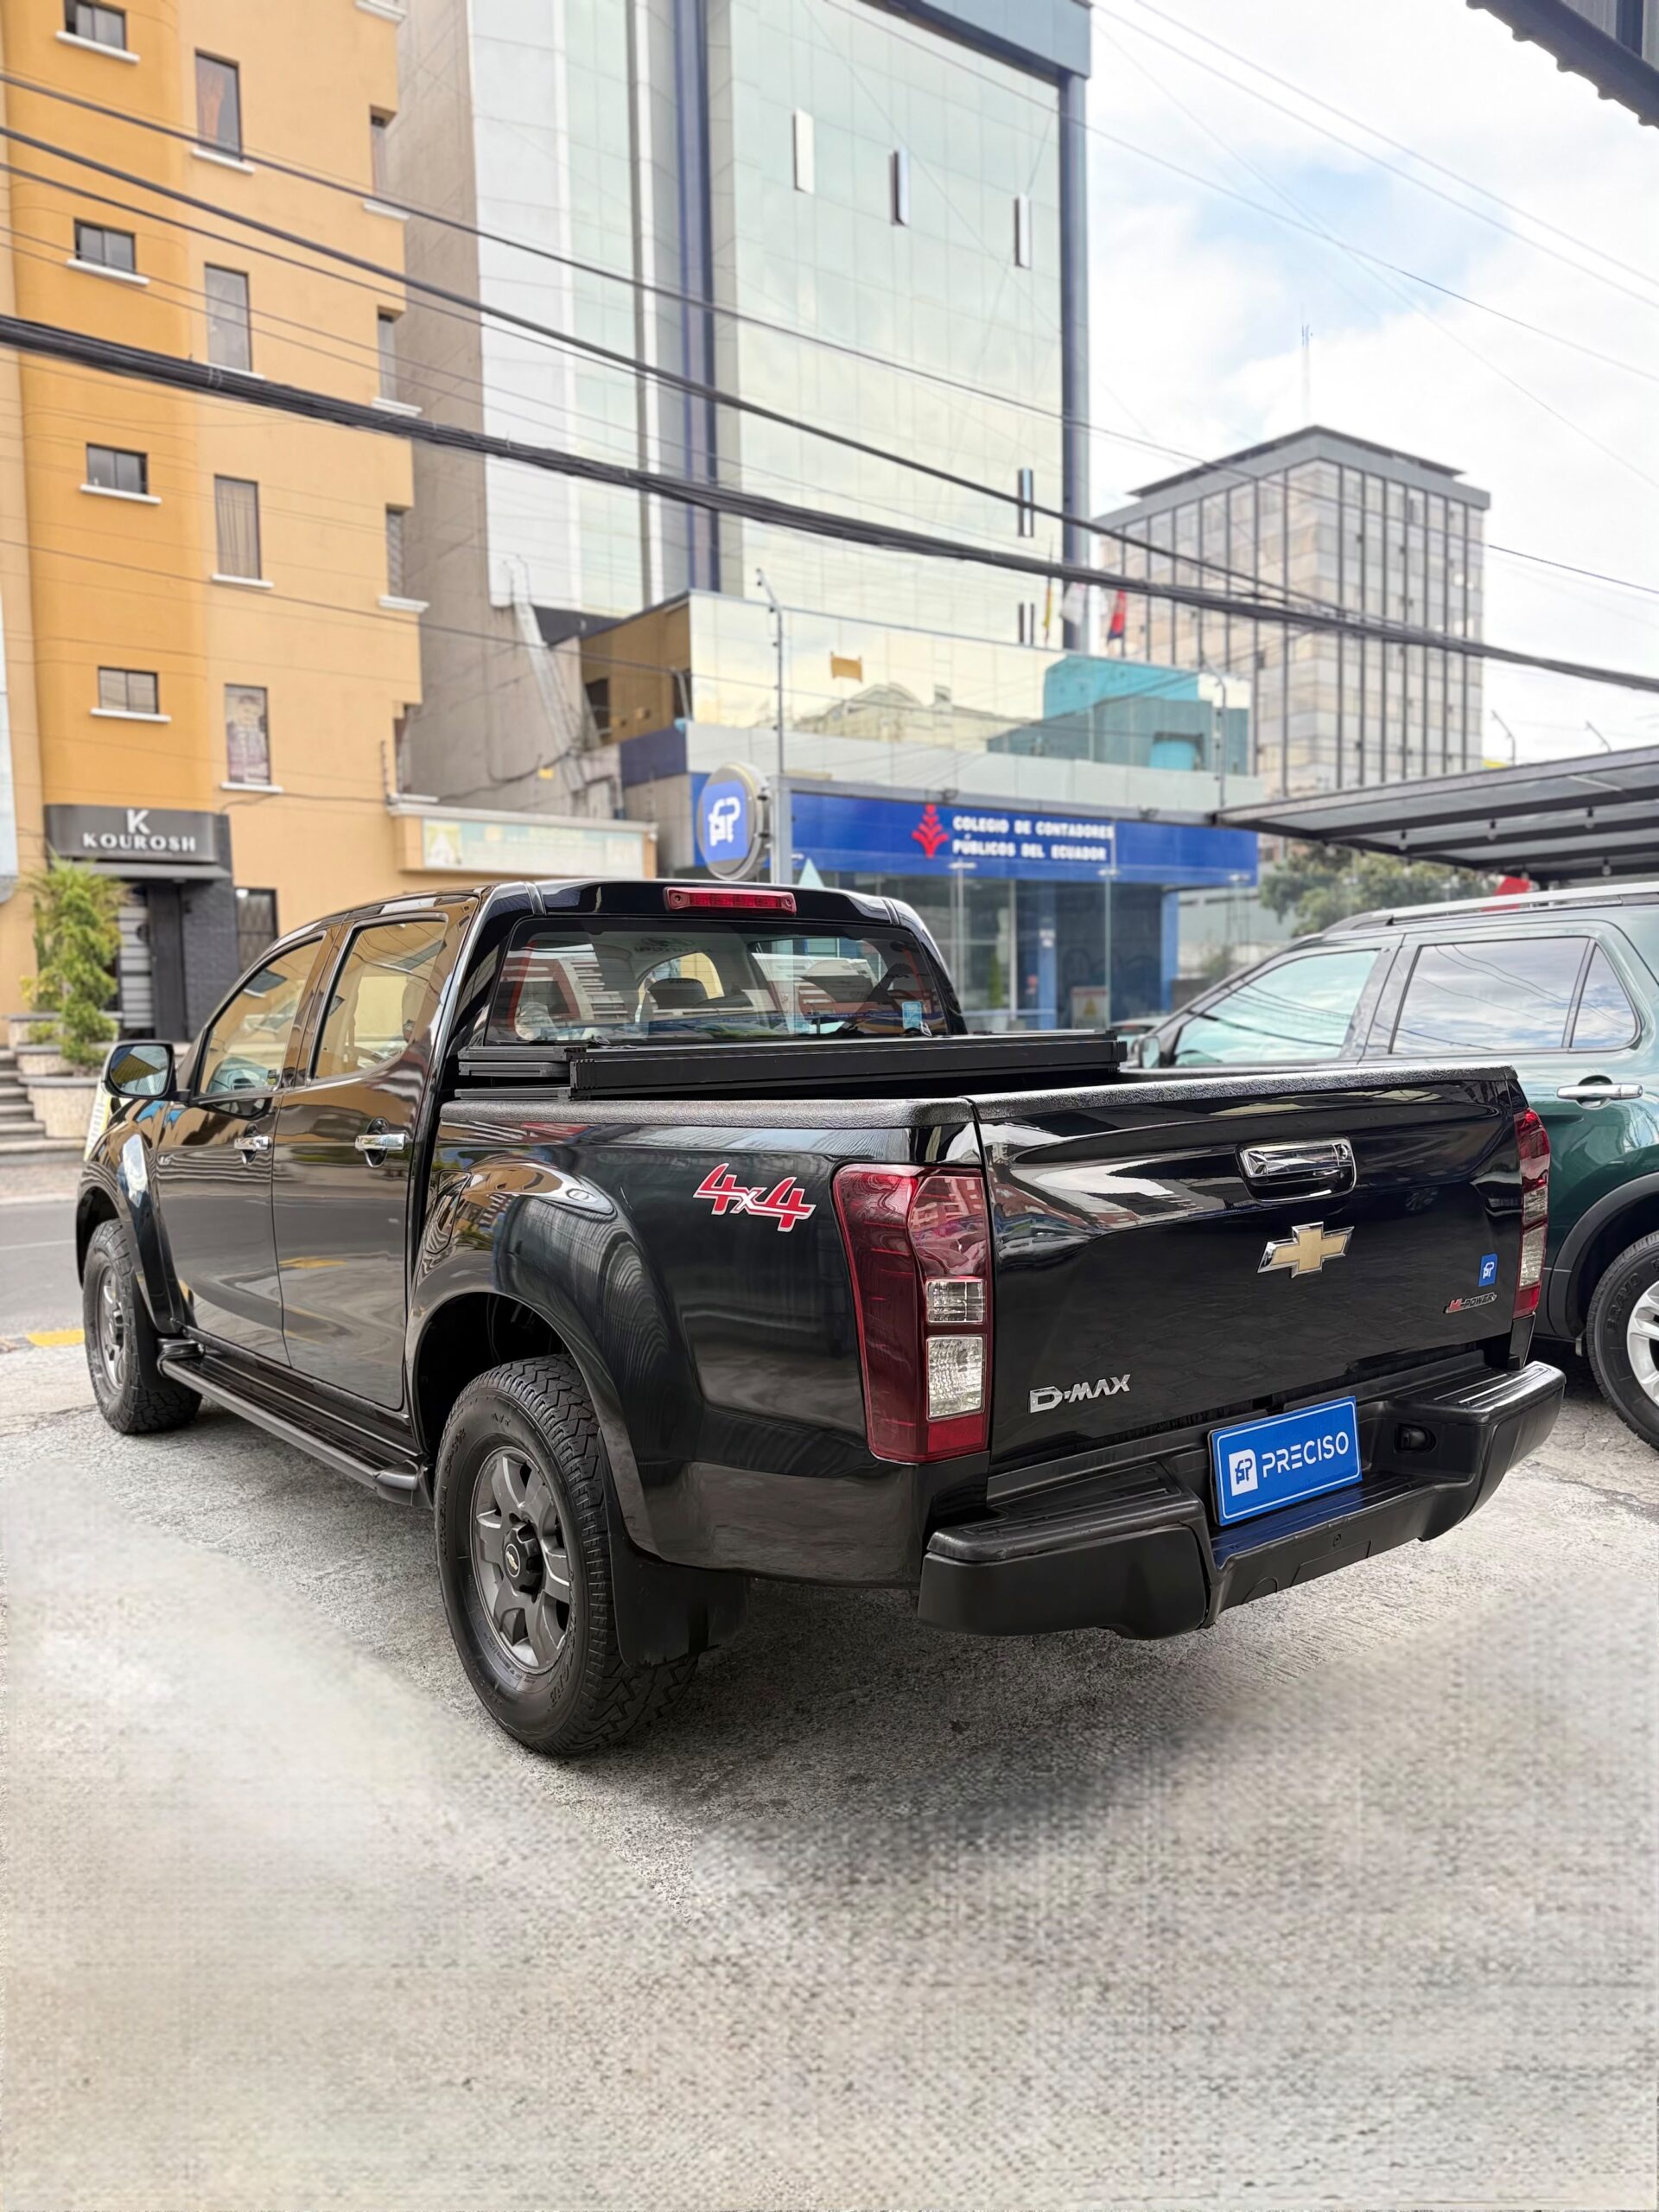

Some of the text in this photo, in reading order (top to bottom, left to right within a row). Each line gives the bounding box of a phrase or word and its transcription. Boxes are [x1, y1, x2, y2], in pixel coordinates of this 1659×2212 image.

[126, 809, 150, 835] K
[952, 816, 1115, 840] COLEGIO DE CONTADORES
[83, 832, 195, 852] KOUROSH
[952, 833, 1107, 861] PÚBLICOS DEL ECUADOR
[1030, 1374, 1130, 1414] D-MAX
[1261, 1431, 1350, 1478] PRECISO
